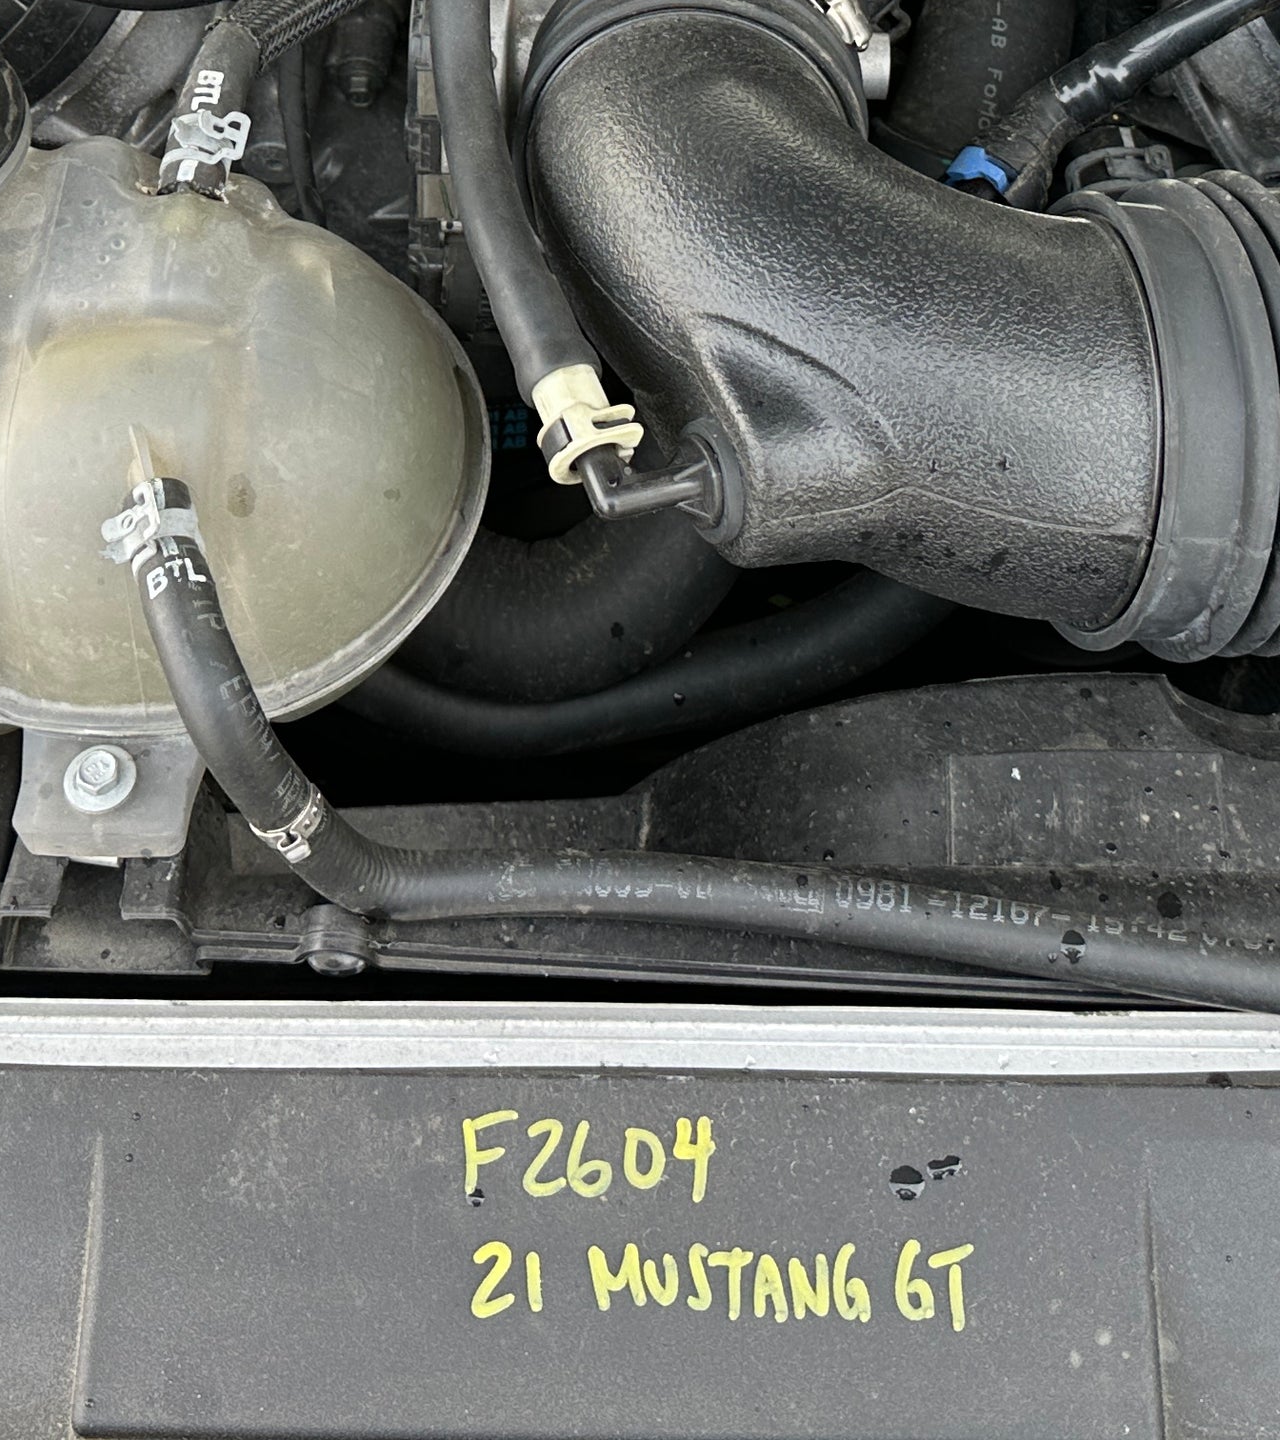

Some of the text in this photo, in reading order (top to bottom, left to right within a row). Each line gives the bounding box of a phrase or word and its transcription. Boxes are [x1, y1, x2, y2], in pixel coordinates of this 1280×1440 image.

[146, 557, 206, 600] BTL
[462, 1109, 716, 1202] F2604
[471, 1240, 974, 1332] 21 MUSTANG GT
